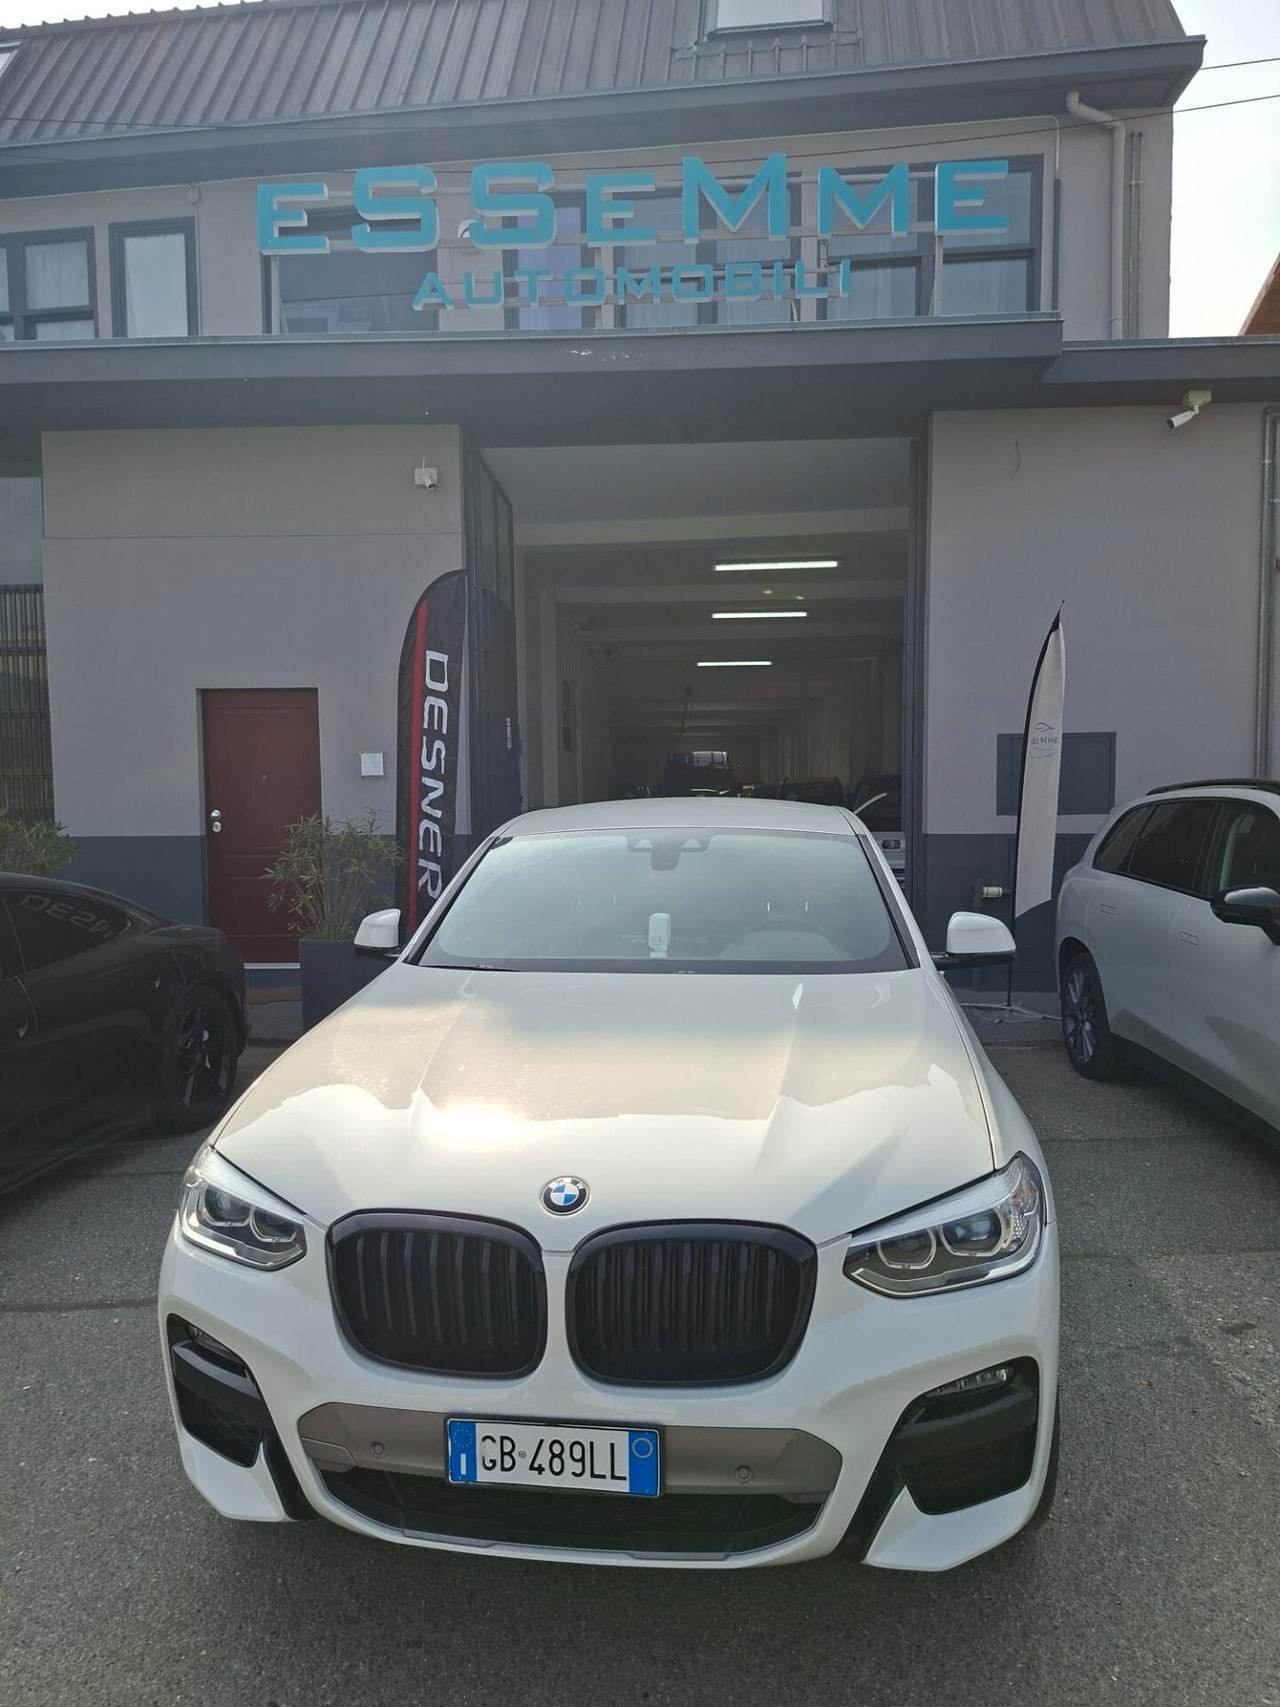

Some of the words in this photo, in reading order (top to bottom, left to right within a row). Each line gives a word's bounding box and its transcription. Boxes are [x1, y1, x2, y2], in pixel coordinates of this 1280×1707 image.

[257, 153, 1010, 256] ESSEMME
[412, 259, 852, 311] AUTOMOBILI
[417, 649, 449, 900] DESNER
